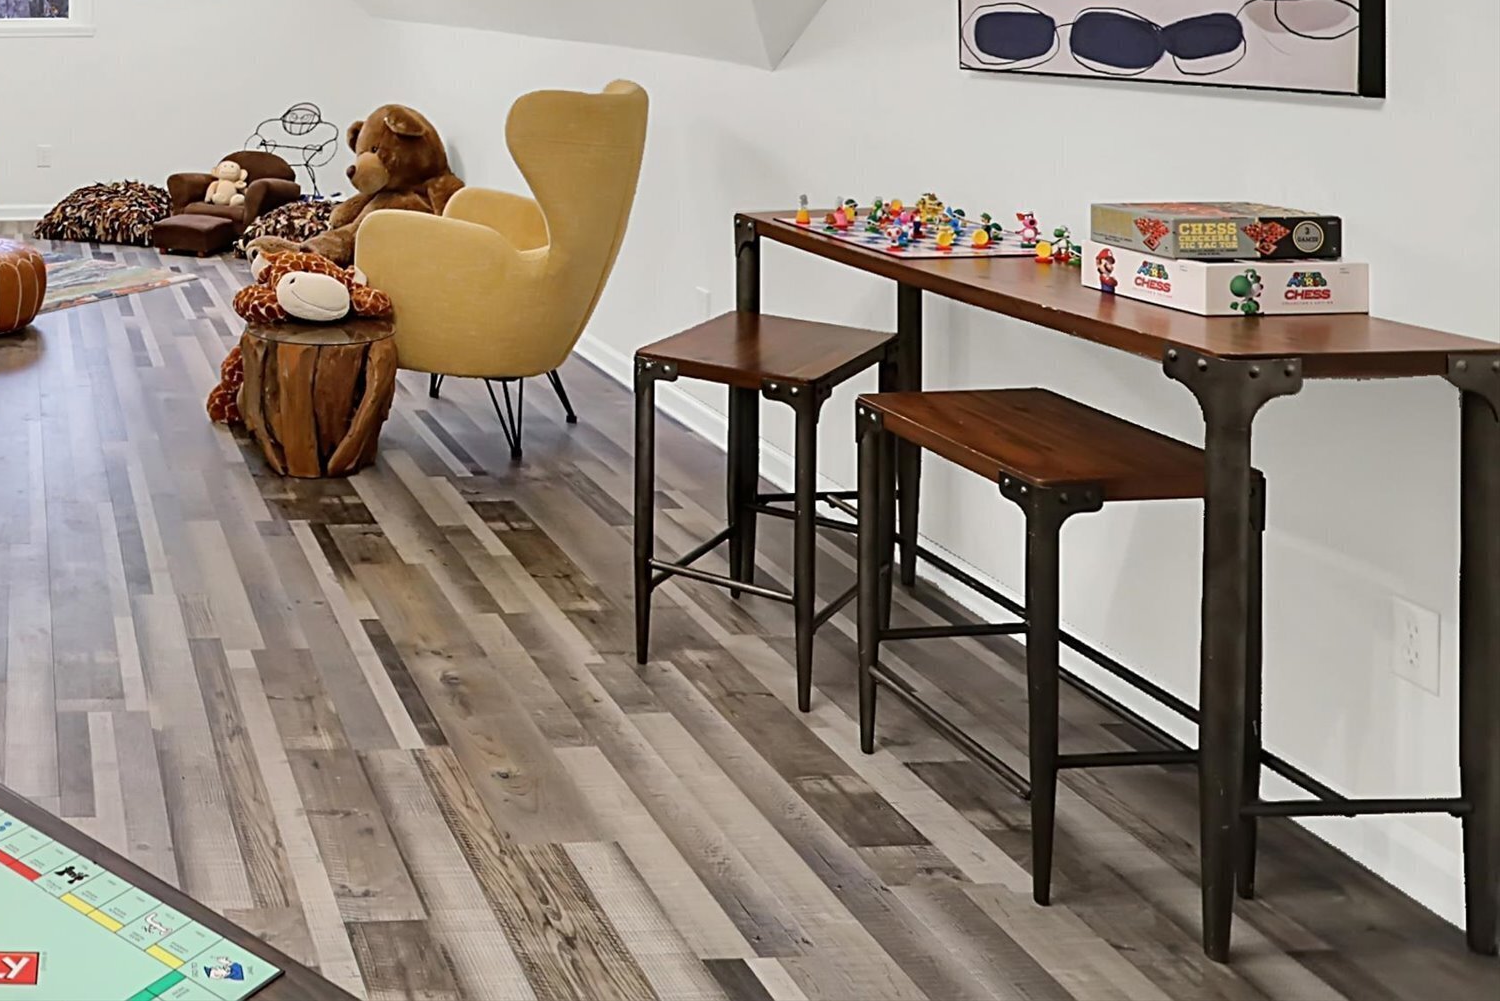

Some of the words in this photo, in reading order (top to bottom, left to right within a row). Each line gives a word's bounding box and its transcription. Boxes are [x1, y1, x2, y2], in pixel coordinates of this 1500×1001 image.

[1179, 223, 1237, 235] CHESS
[1134, 276, 1172, 293] CHESS
[1284, 288, 1331, 300] CHESS
